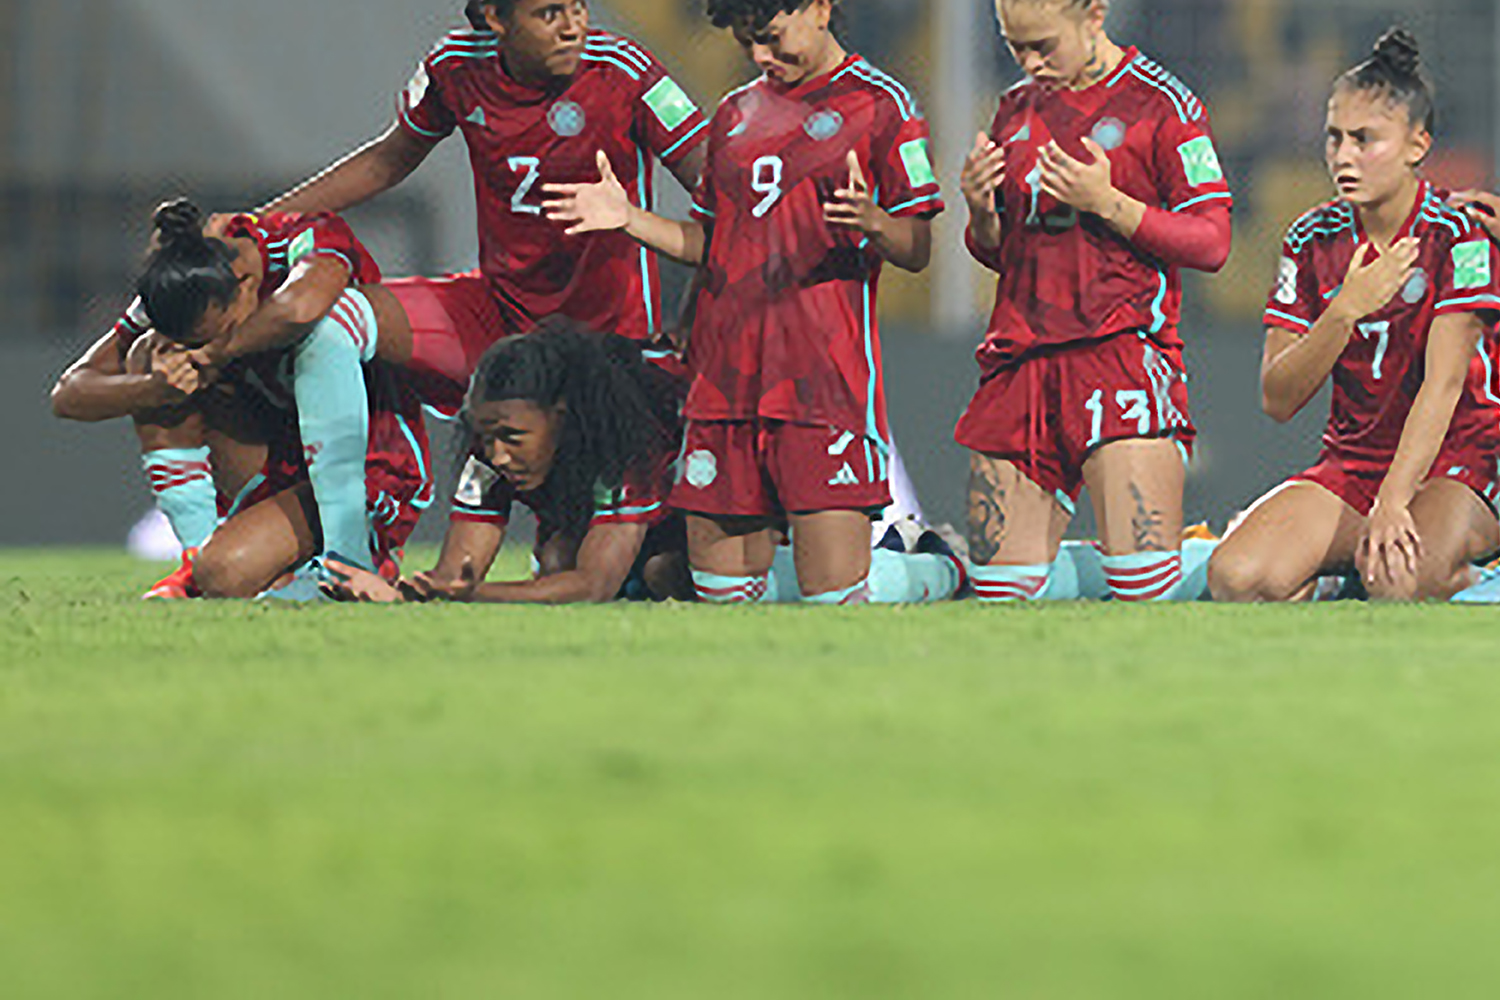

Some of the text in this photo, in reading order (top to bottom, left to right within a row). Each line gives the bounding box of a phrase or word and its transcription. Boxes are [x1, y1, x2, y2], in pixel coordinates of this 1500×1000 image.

[507, 156, 540, 215] 2
[751, 155, 783, 217] 9
[1357, 320, 1390, 379] 7
[1085, 389, 1151, 447] 13
